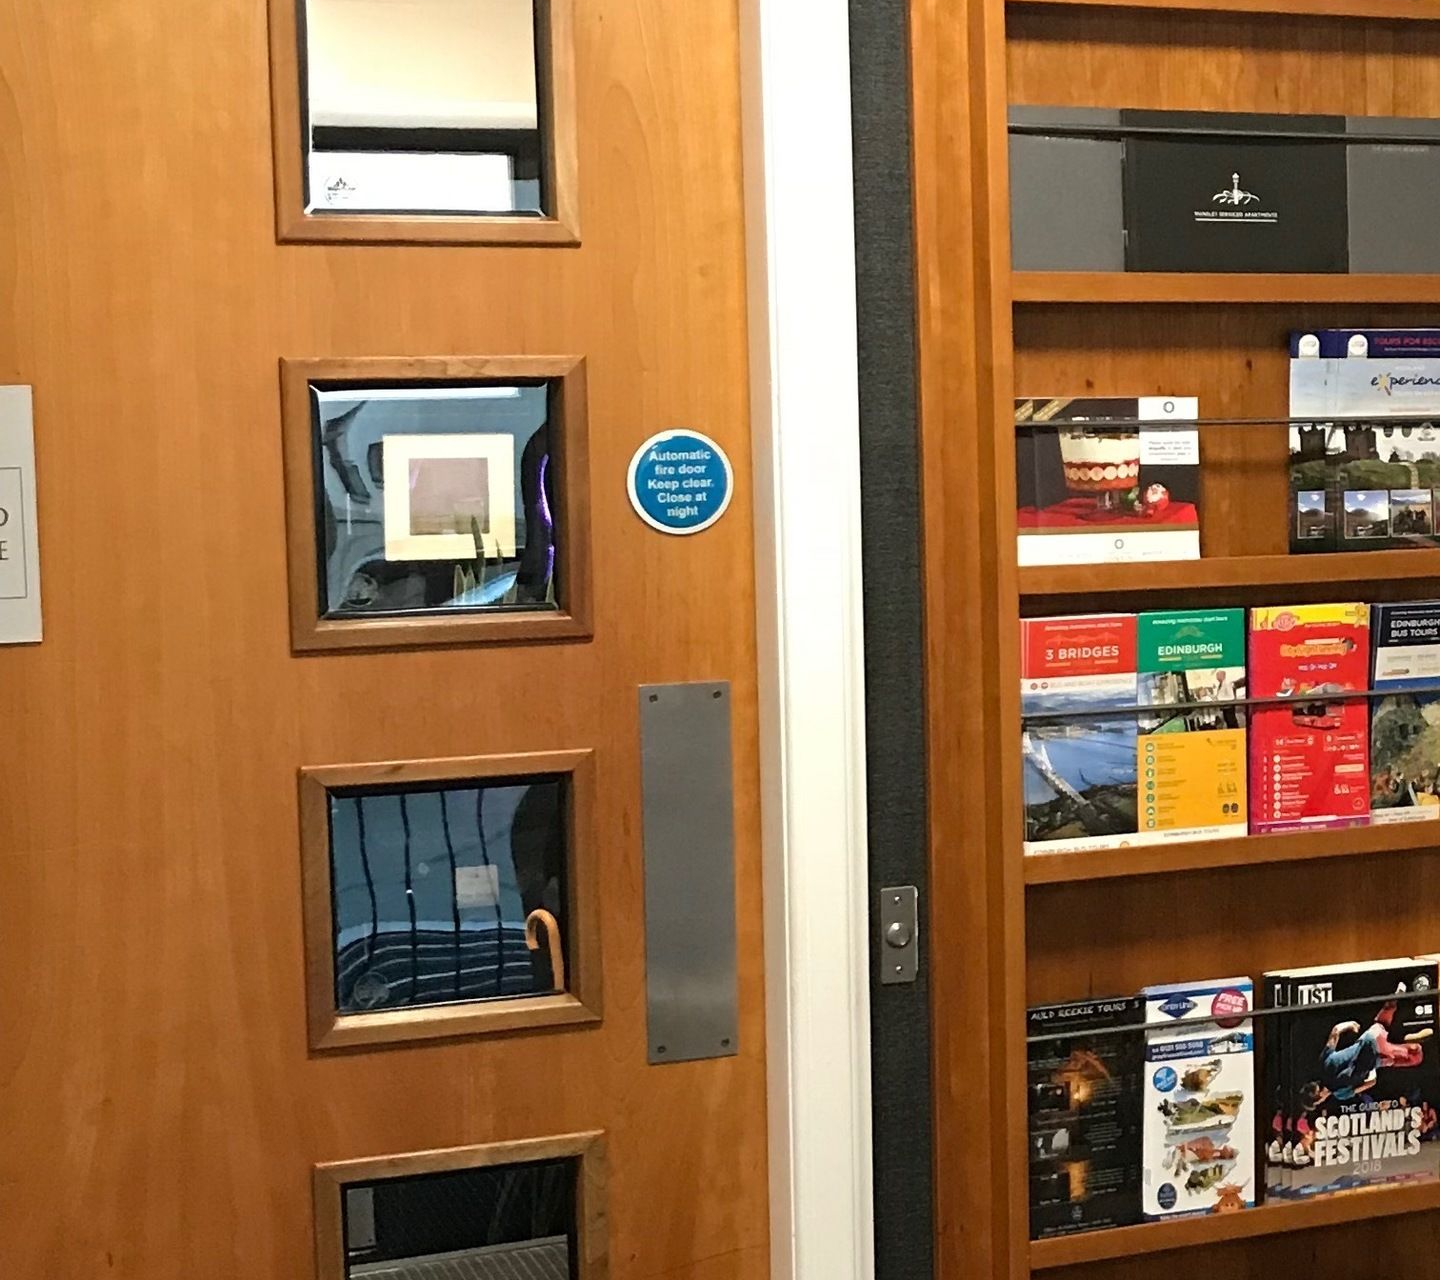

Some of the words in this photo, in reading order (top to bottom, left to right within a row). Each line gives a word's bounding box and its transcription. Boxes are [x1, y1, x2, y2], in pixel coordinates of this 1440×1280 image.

[648, 449, 712, 461] Automatic
[654, 464, 675, 475] fire
[678, 464, 707, 475] door
[648, 478, 679, 491] Keep
[657, 492, 692, 503] Close
[667, 505, 698, 519] night
[1391, 619, 1440, 629] EDINBURGH
[1045, 649, 1054, 661] 3
[1058, 645, 1120, 660] BRIDGES
[1158, 643, 1223, 656] EDINBURGH
[1219, 993, 1245, 1006] FREE
[1058, 1006, 1094, 1017] REEKIE
[1098, 1002, 1126, 1013] TOURS
[1315, 1106, 1424, 1140] SCOTLAND'S
[1314, 1129, 1421, 1167] FESTIVALS
[1353, 1161, 1382, 1175] 2018
